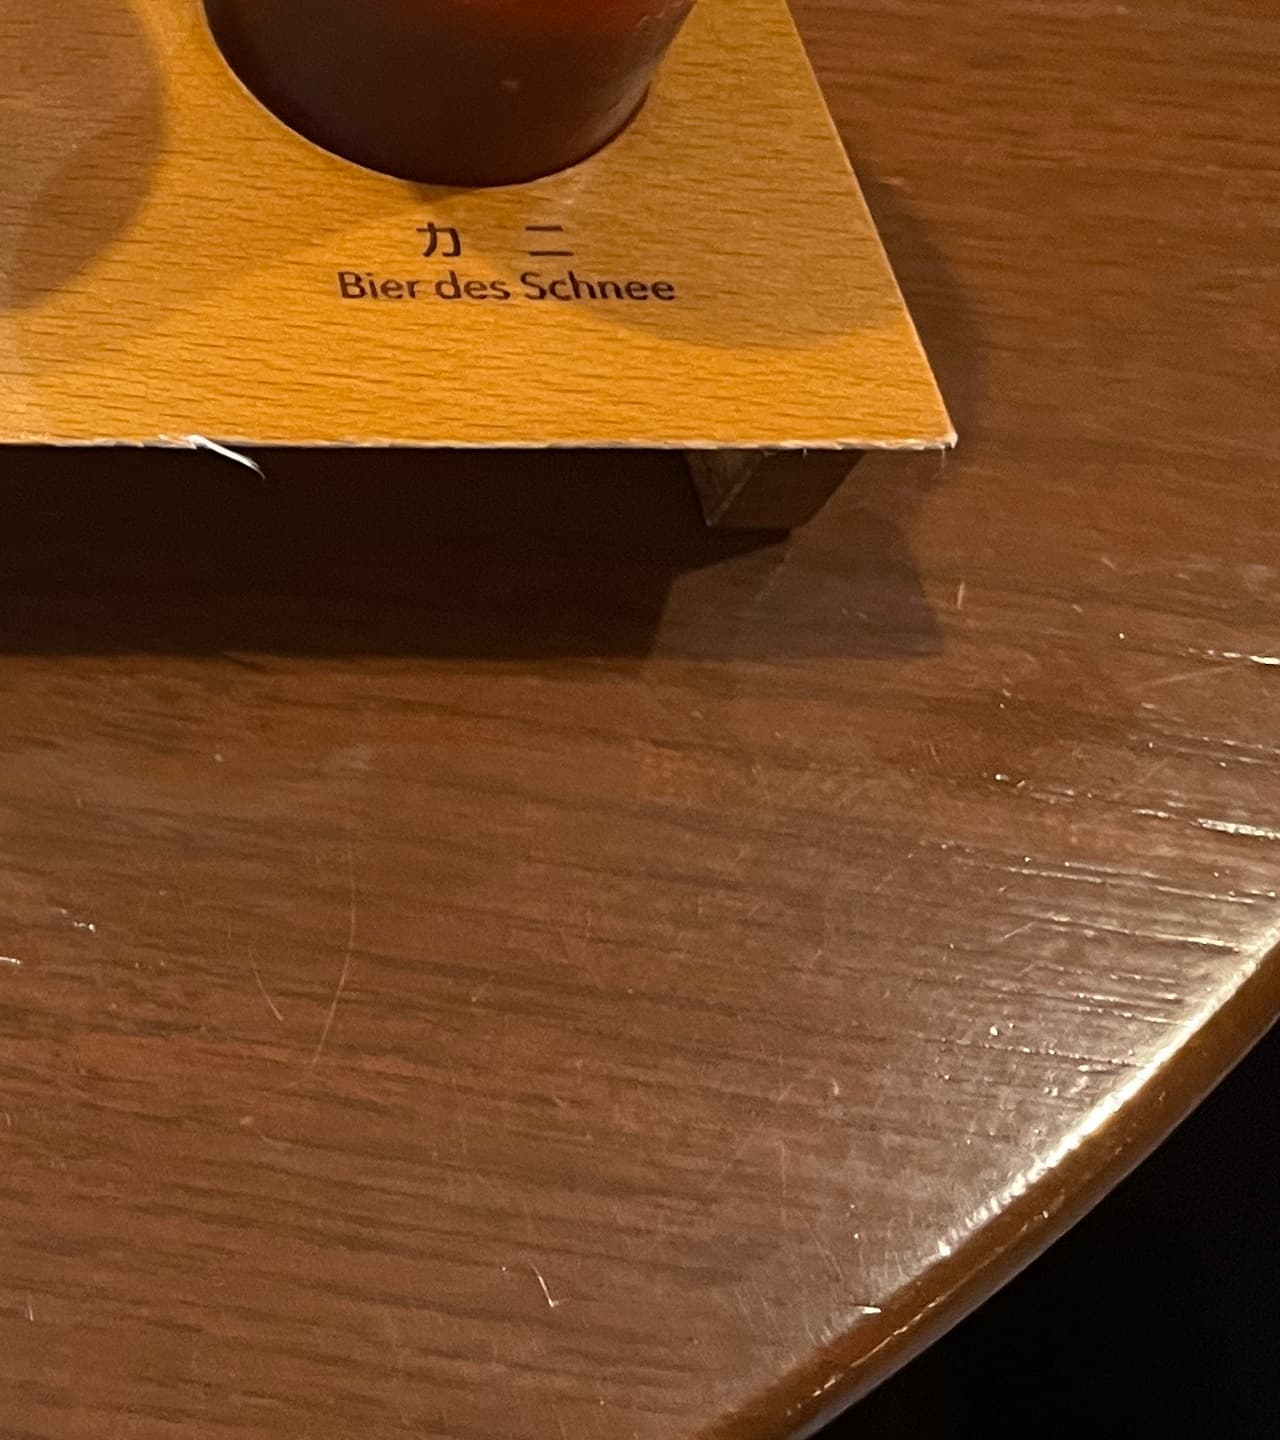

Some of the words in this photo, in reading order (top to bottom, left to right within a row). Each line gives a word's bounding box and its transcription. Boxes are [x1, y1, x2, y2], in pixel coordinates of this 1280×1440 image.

[338, 271, 421, 300] Bier
[434, 270, 510, 301] des
[520, 270, 675, 301] Schnee
